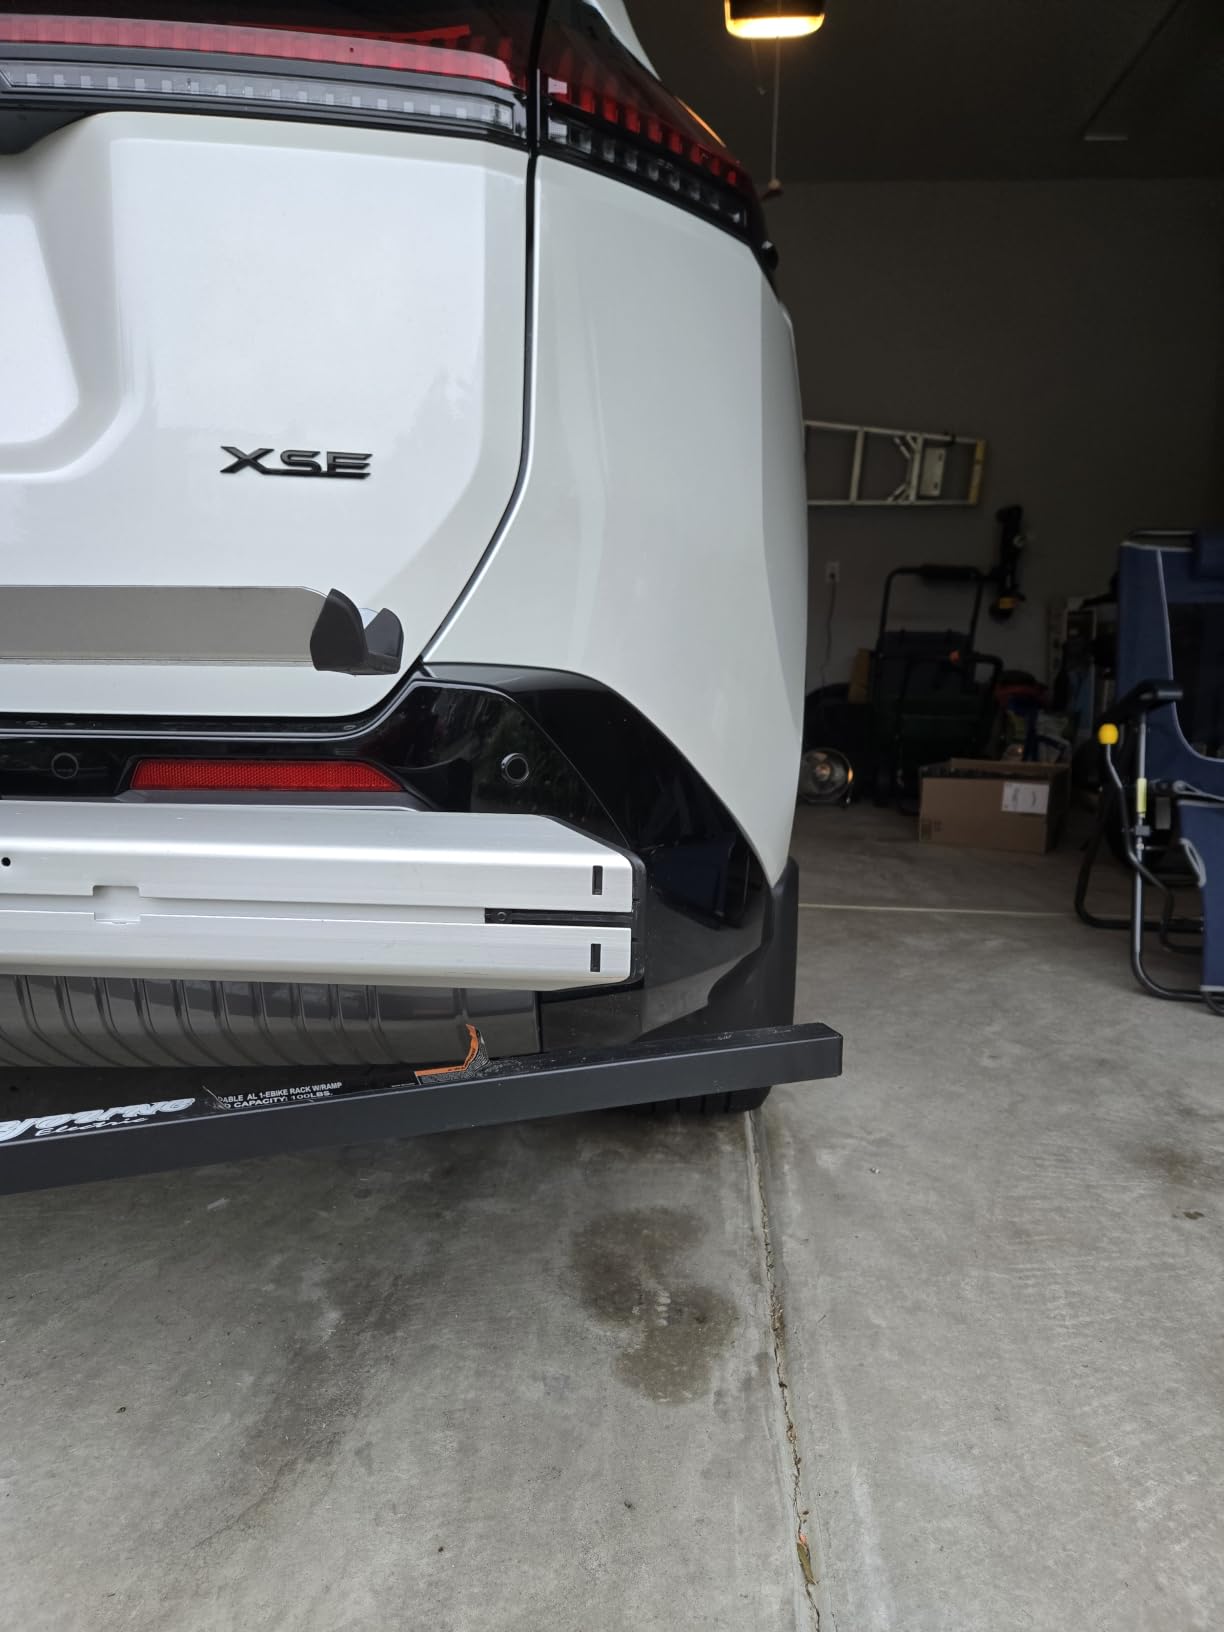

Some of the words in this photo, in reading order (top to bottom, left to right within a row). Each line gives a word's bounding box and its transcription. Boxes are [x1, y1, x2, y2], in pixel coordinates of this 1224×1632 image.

[220, 446, 373, 479] XSE
[247, 1092, 258, 1101] AL
[260, 1089, 289, 1099] 1-EBIKE
[289, 1086, 311, 1095] RACK
[312, 1082, 342, 1092] W/RAMP
